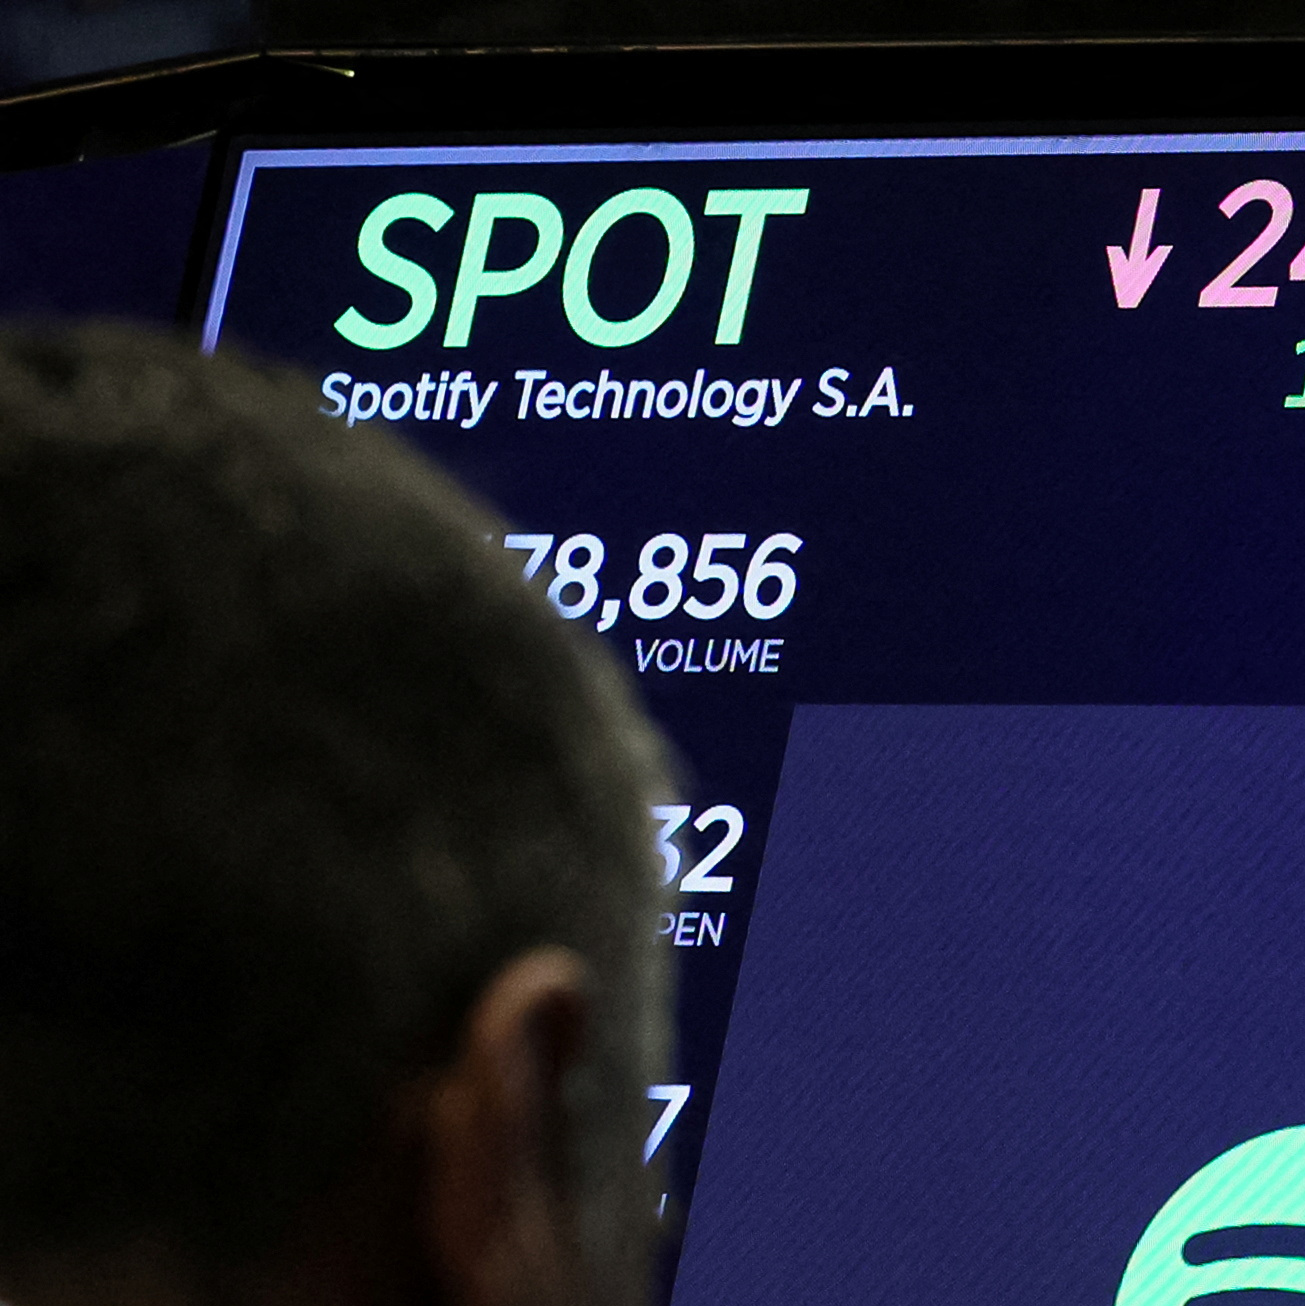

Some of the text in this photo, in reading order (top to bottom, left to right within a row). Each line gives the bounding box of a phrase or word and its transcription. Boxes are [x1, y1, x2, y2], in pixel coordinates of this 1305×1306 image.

[334, 188, 809, 350] SPOT
[319, 366, 914, 430] Spotify Technology S.A.
[482, 532, 803, 633] 78,856
[634, 638, 785, 673] VOLUME
